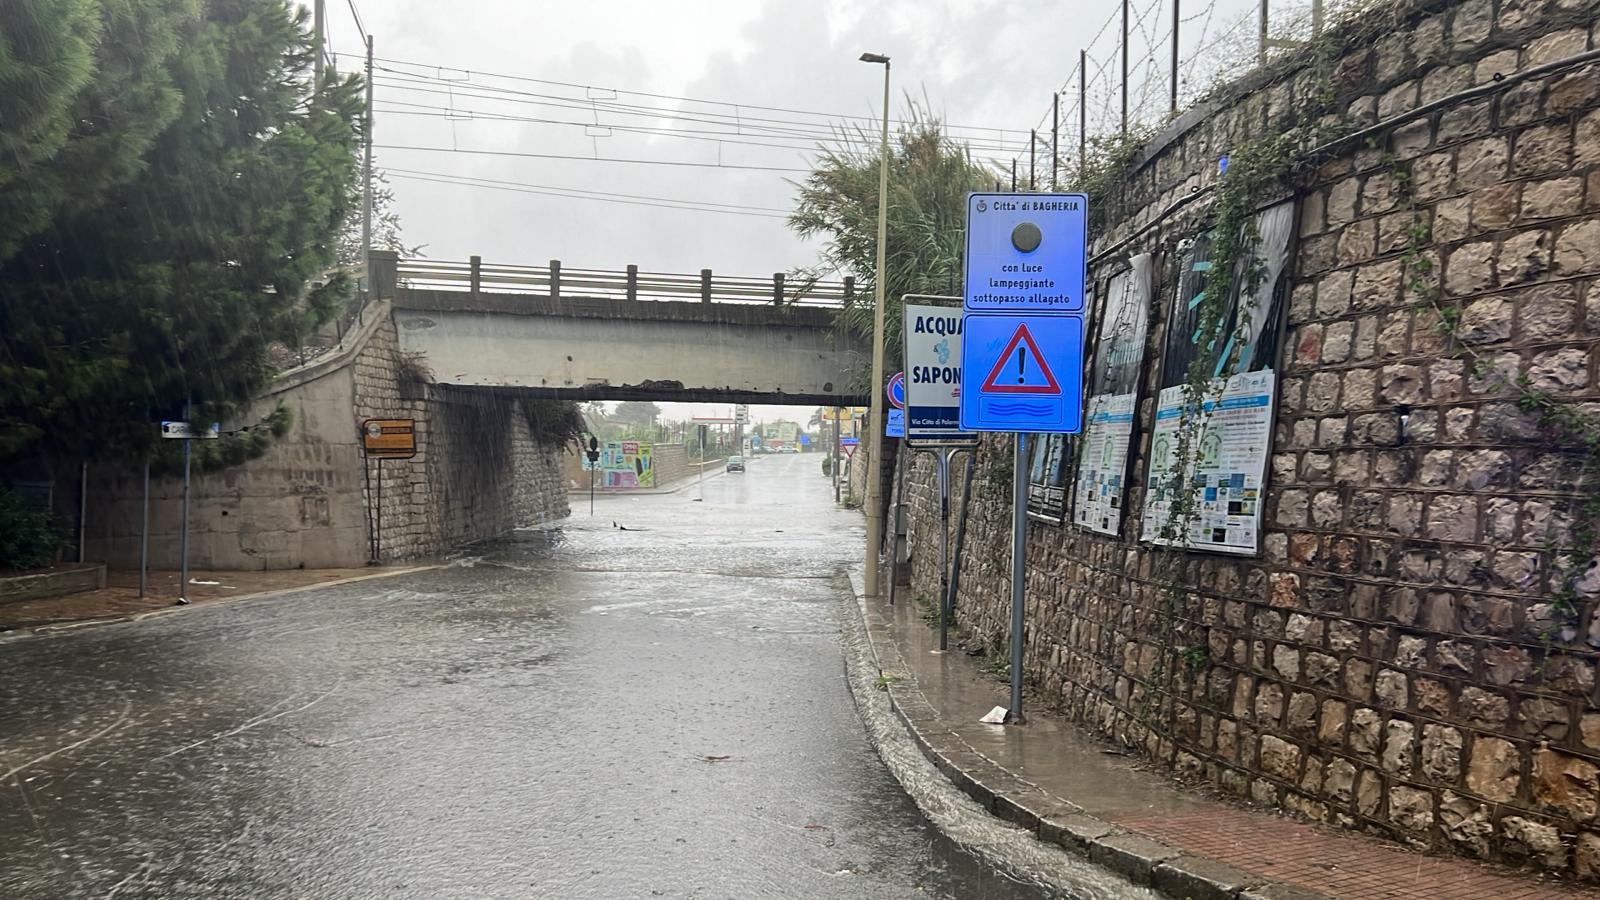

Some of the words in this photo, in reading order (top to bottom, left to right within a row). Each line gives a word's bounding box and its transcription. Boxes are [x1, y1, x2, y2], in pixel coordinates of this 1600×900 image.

[1021, 201, 1030, 211] di
[1033, 201, 1079, 212] BAGHERIA
[1002, 265, 1019, 273] con
[1022, 263, 1043, 273] luce
[989, 278, 1055, 290] lampeggiante
[973, 293, 1025, 304] sottopasso
[1028, 294, 1070, 305] allagato
[913, 366, 962, 384] SAPON
